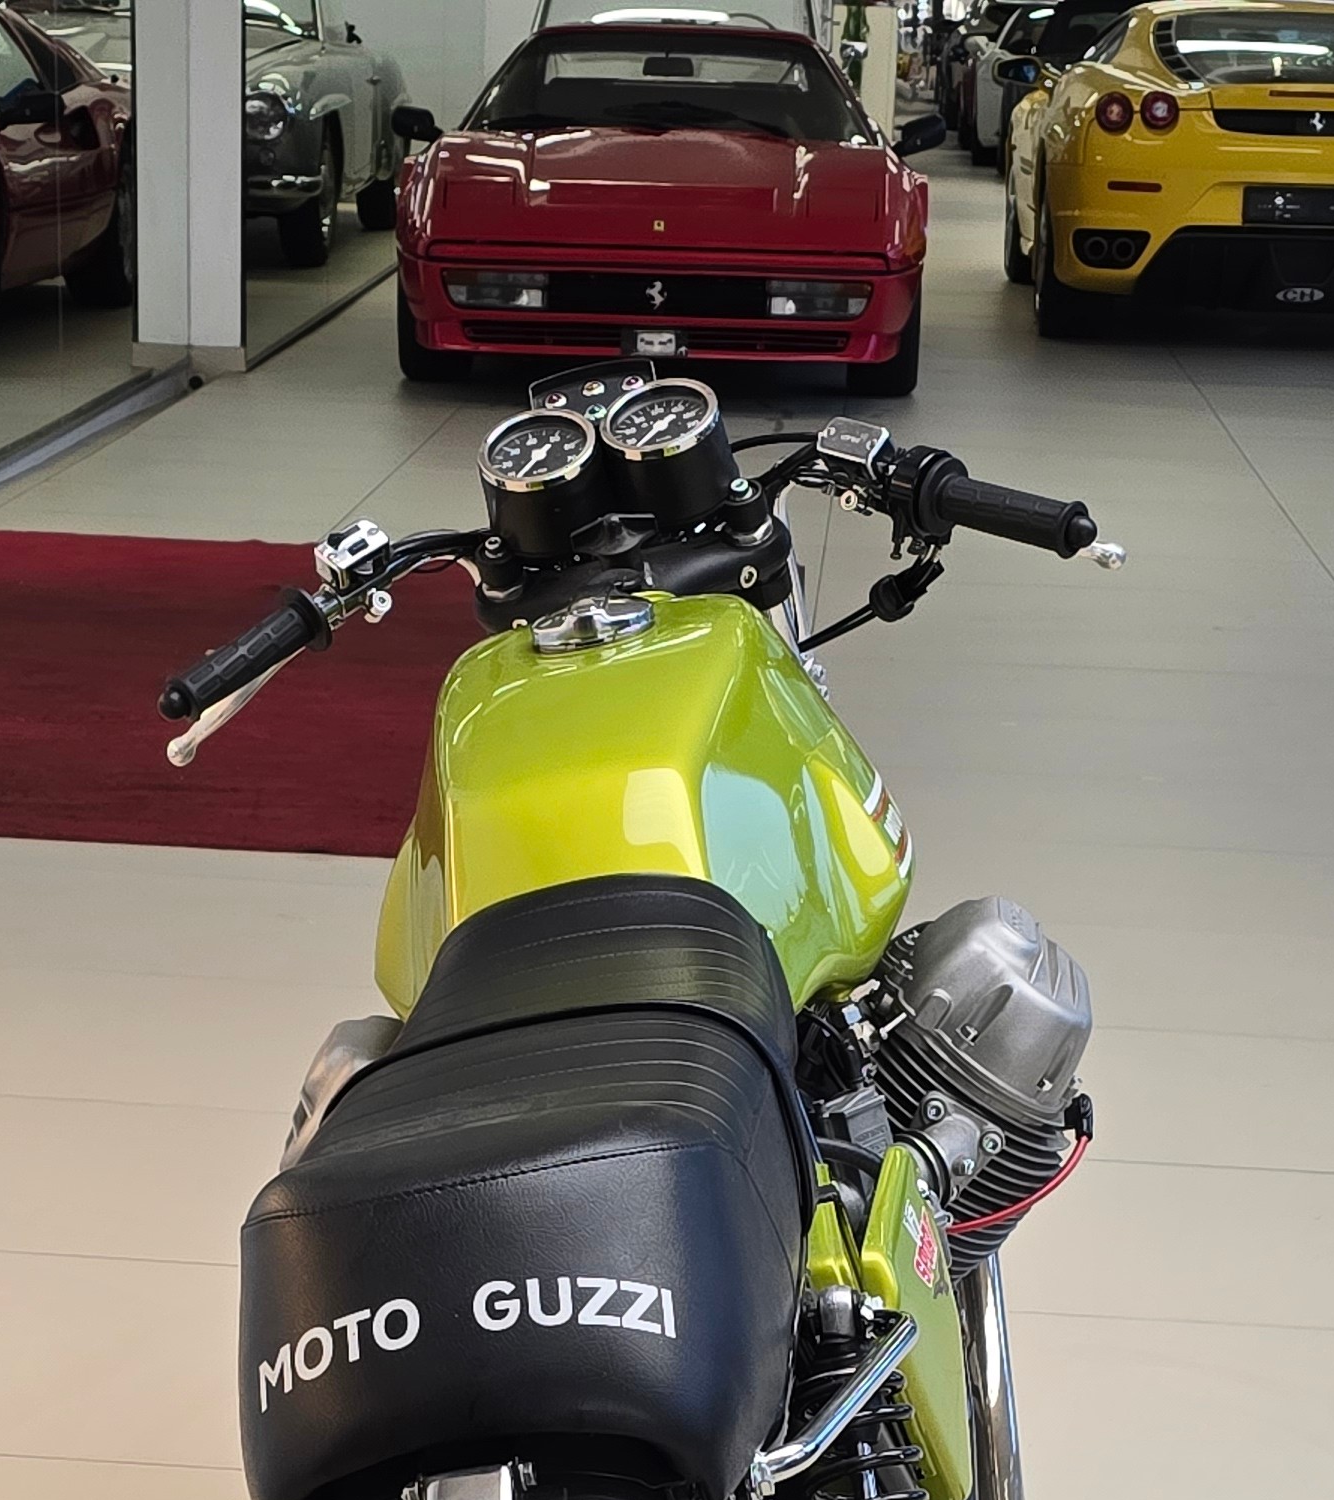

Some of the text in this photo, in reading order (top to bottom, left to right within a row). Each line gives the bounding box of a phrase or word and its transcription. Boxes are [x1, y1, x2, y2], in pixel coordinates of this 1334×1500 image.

[1282, 287, 1315, 303] CH
[257, 1275, 677, 1413] MOTO GUZZI
